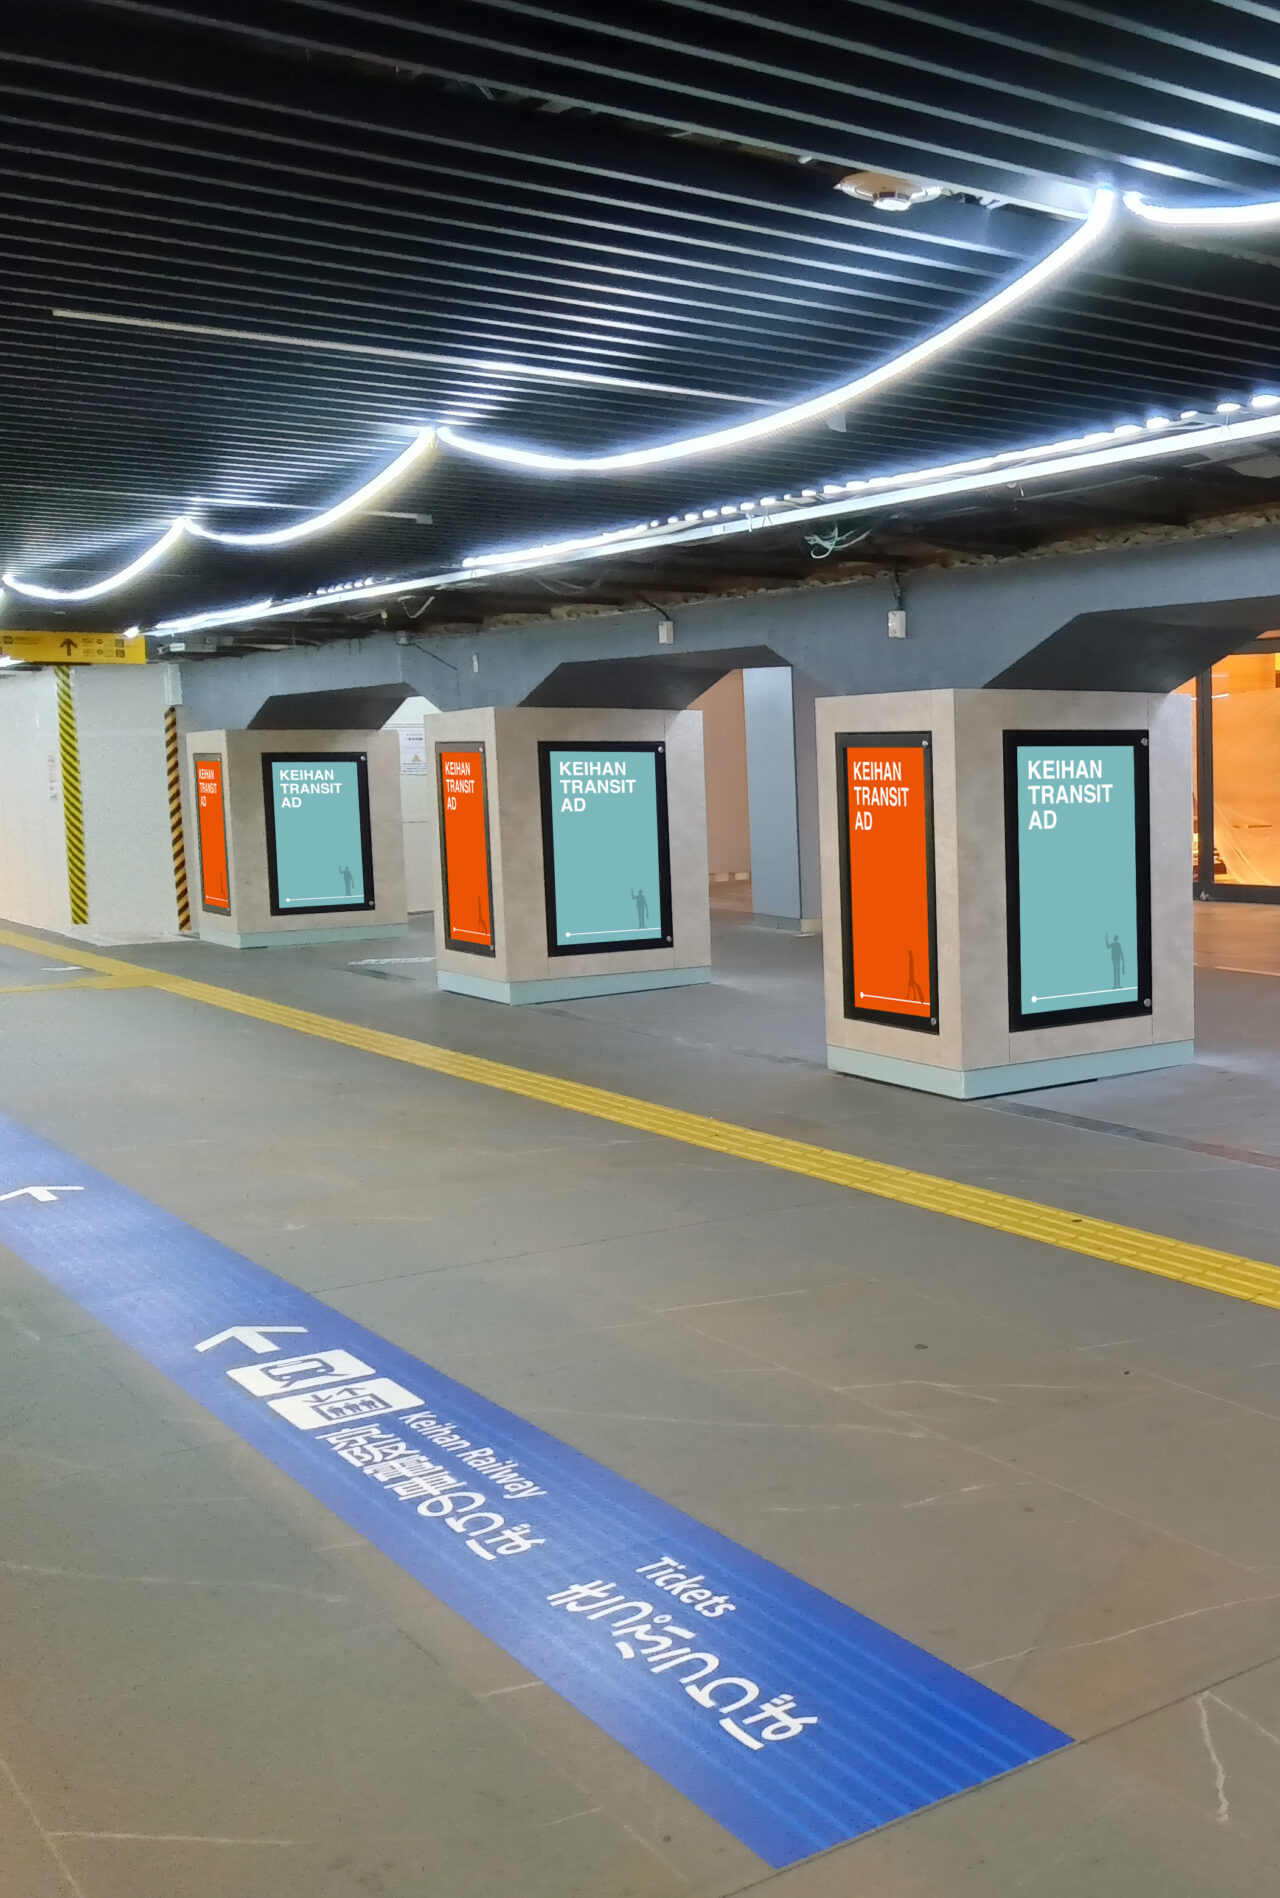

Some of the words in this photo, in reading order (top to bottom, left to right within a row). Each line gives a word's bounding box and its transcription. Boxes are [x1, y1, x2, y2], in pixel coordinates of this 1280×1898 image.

[279, 769, 335, 781] KEIHAN
[445, 762, 471, 776] KEIHAN
[559, 761, 626, 776] KEIHAN
[853, 761, 902, 781] KEIHAN
[1027, 760, 1103, 780] KEIHAN
[279, 782, 343, 795] TRANSIT
[446, 779, 475, 794] TRANSIT
[559, 779, 637, 794] TRANSIT
[854, 785, 910, 807] TRANSIT
[1027, 783, 1114, 805] TRANSIT
[281, 796, 302, 809] AD
[447, 797, 457, 811] AD
[560, 797, 586, 812] AD
[854, 811, 873, 831] AD
[1028, 809, 1058, 830] AD
[399, 1411, 472, 1453] Keihan
[456, 1446, 548, 1500] Railway
[315, 1422, 546, 1561] 京阪電車のりば
[635, 1556, 736, 1618] Tickets
[546, 1580, 818, 1750] きっぷうりば
